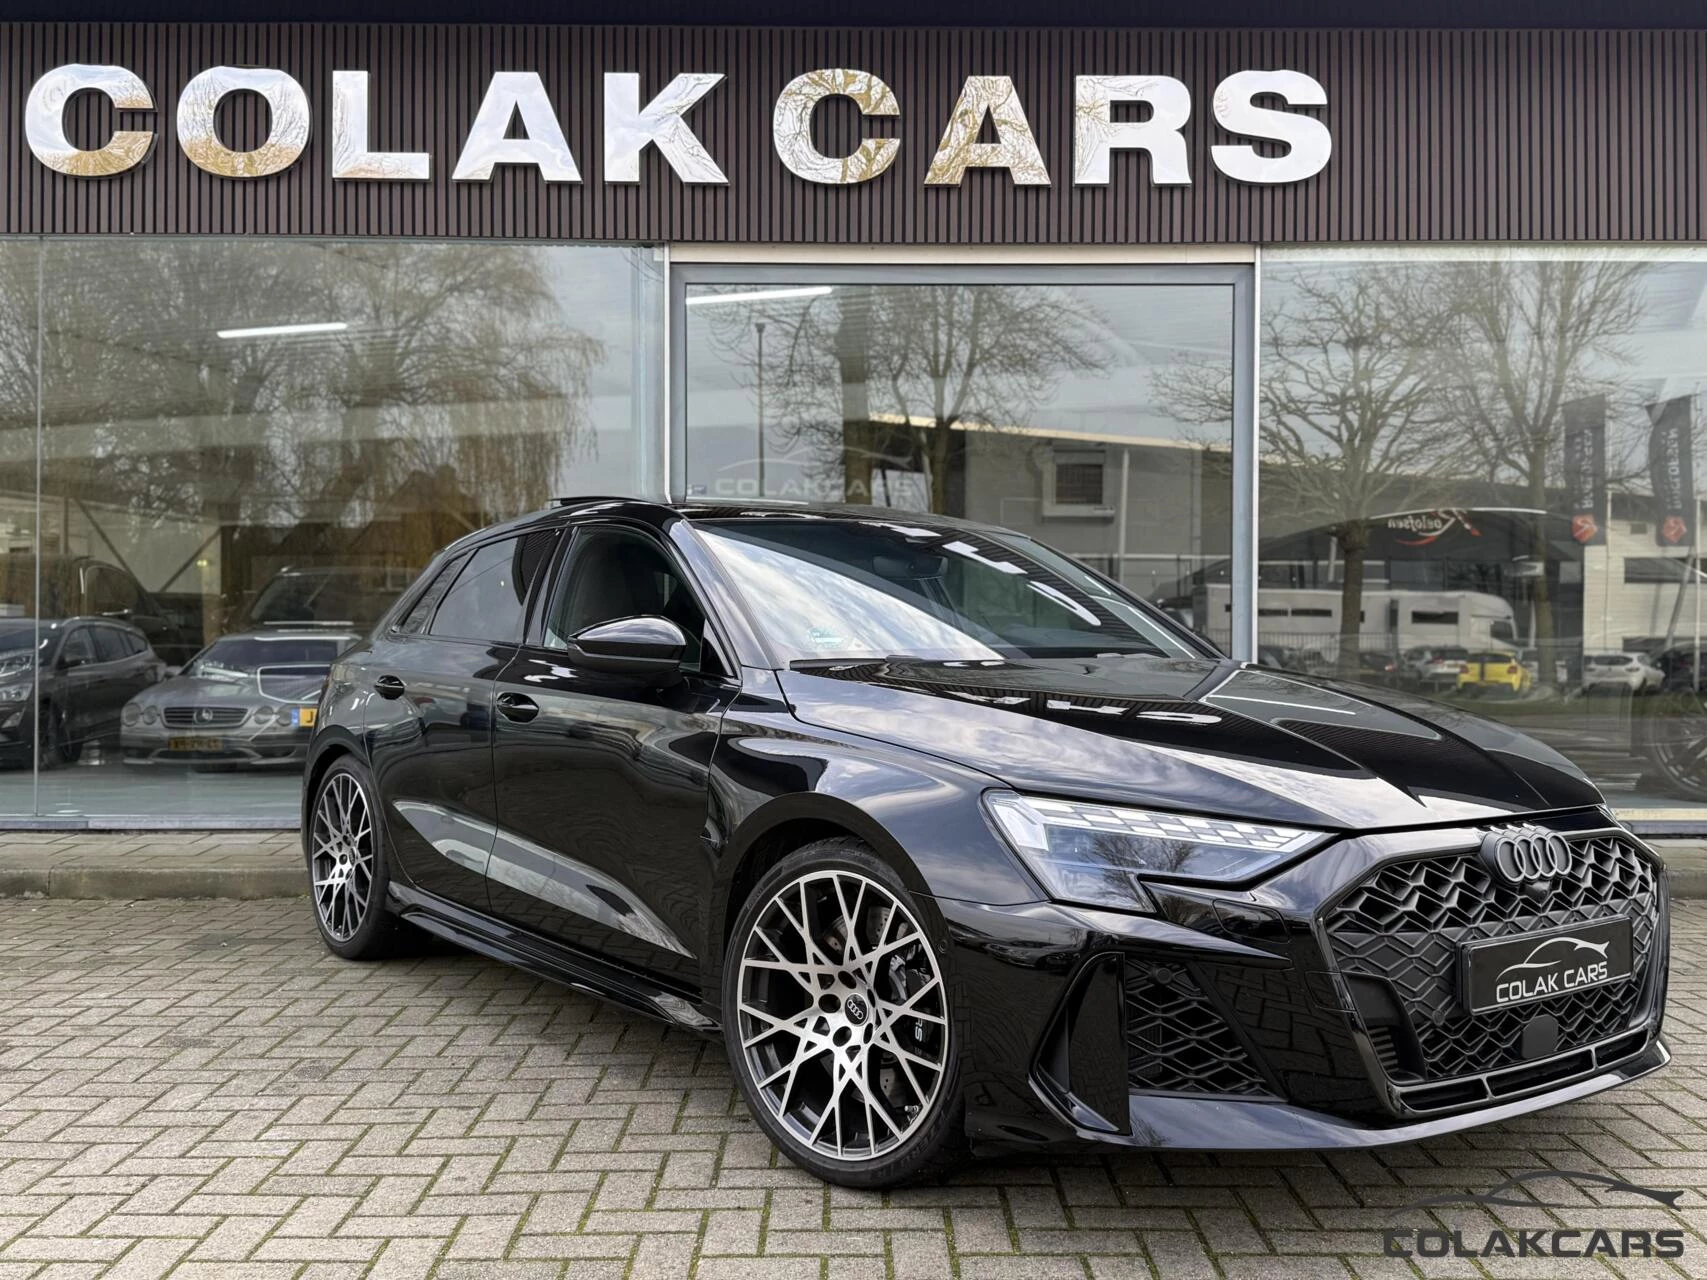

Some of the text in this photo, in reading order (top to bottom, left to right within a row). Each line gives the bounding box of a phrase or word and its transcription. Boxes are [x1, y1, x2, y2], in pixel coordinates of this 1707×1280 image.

[24, 63, 1333, 187] COLAK CARS
[1496, 961, 1608, 1003] COLAK CARS
